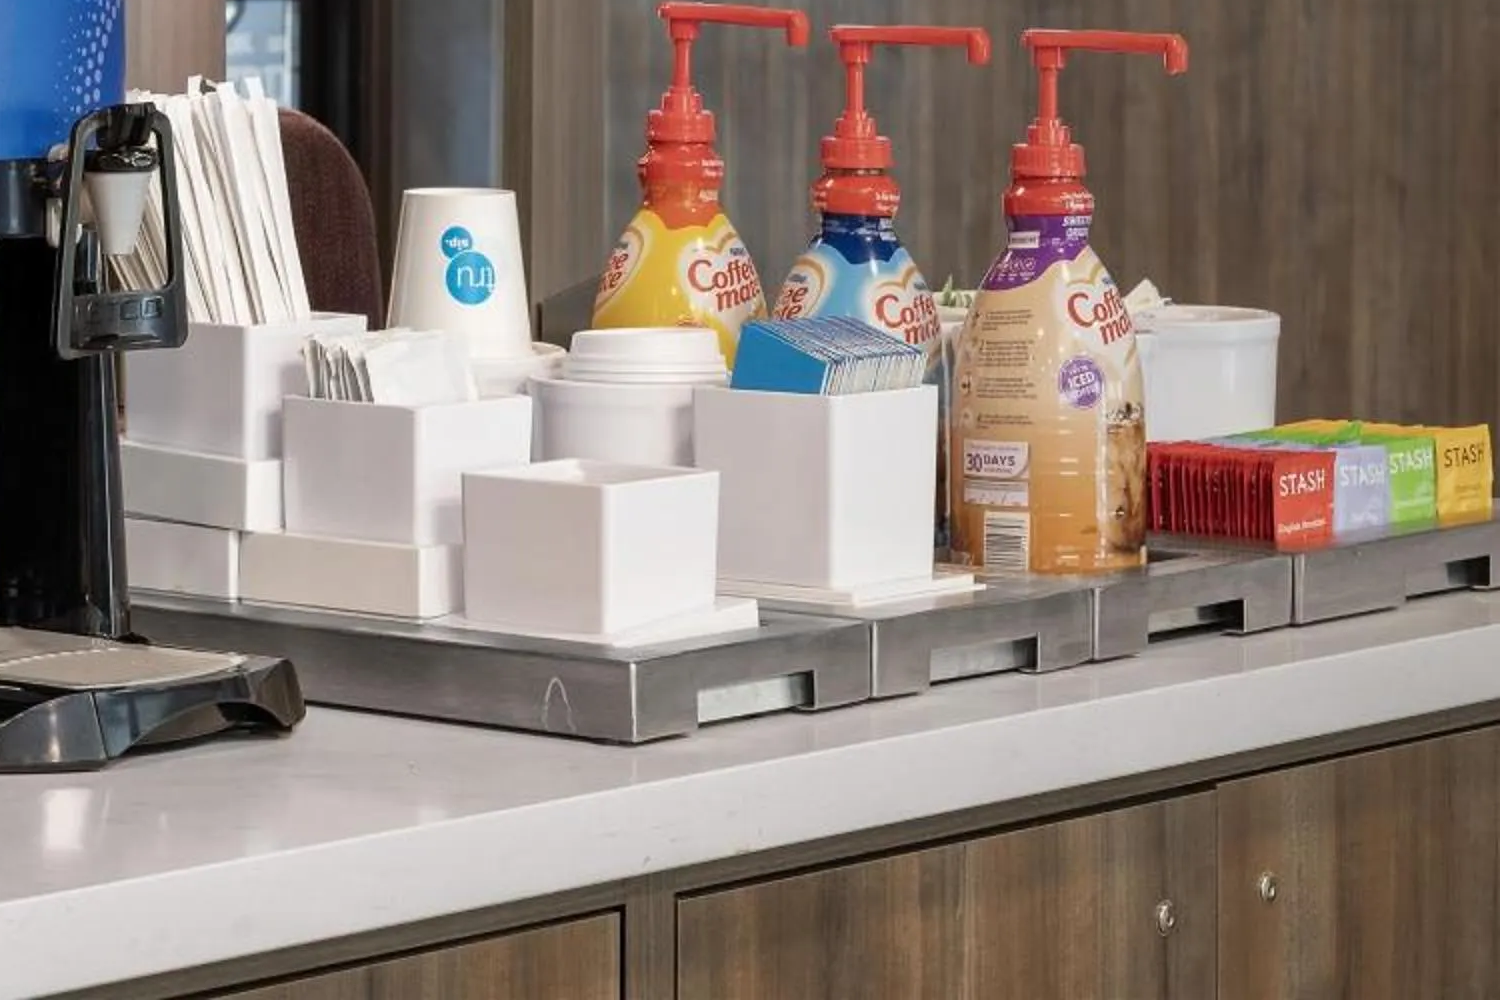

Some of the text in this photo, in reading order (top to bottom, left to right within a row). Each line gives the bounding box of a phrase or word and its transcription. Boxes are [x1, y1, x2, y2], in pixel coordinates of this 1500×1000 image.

[687, 257, 756, 293] Coffe
[966, 452, 1016, 473] 30 DAYS
[1389, 449, 1432, 475] STASH
[1444, 443, 1485, 469] STASH
[1279, 467, 1325, 497] STASH
[1339, 463, 1385, 488] STASH
